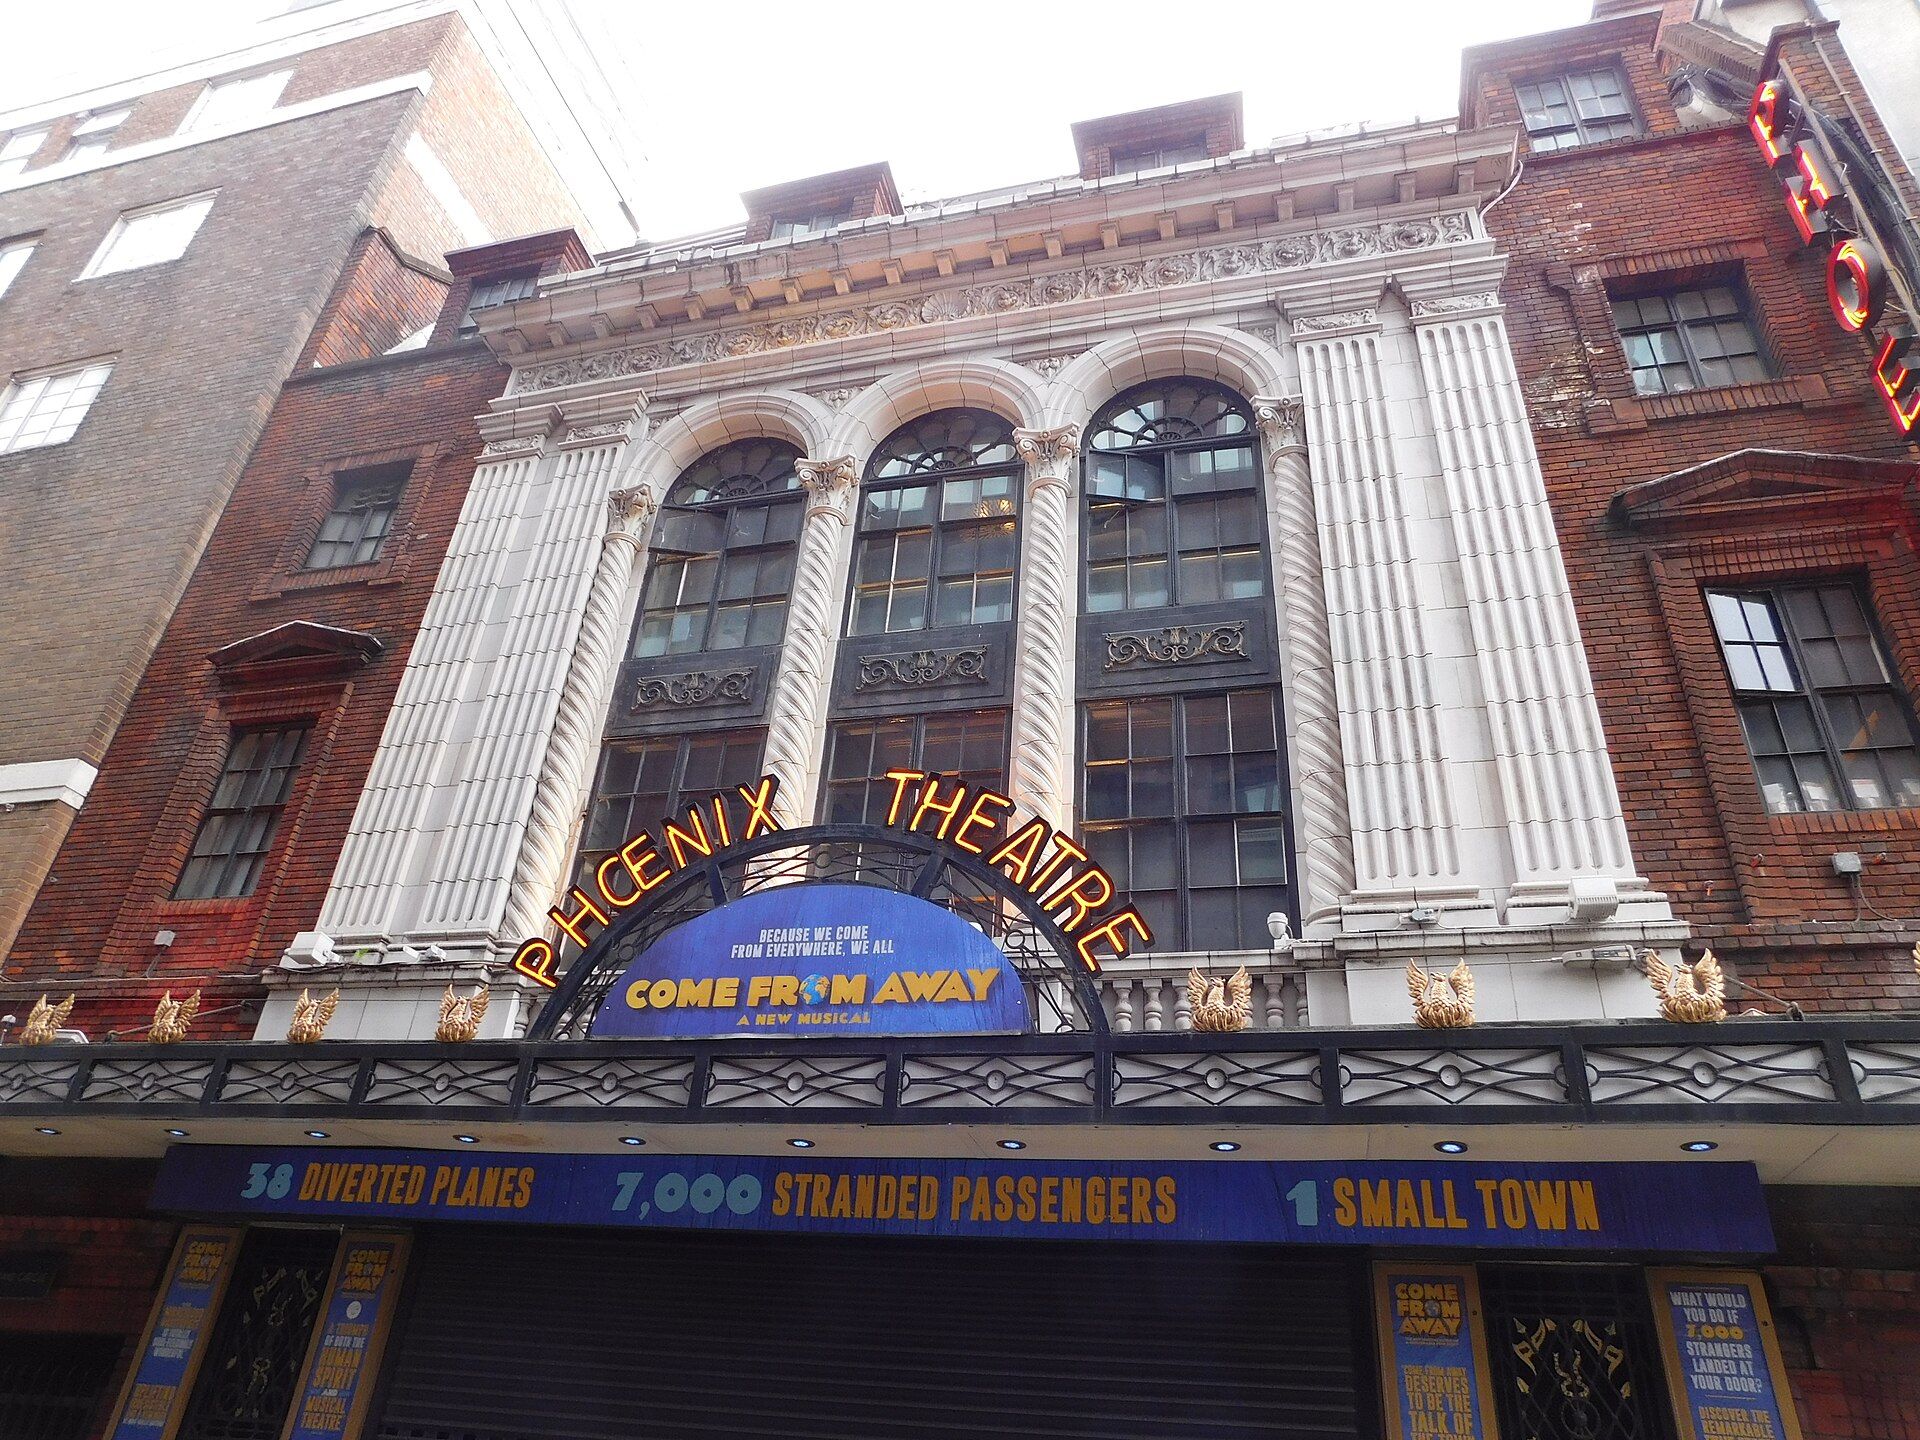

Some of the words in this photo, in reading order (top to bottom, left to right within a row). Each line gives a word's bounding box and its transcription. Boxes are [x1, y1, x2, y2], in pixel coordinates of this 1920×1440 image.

[885, 767, 1155, 979] THEATRE
[759, 927, 810, 943] BECAUSE
[813, 926, 833, 941] WE
[836, 925, 869, 940] COME
[731, 944, 763, 959] FROM
[766, 941, 846, 958] EVERYWHERE,
[851, 940, 870, 955] WE
[872, 939, 894, 954] ALL
[625, 977, 741, 1010] COME
[747, 972, 868, 1007] FROM
[871, 967, 1000, 1005] AWAY
[736, 1014, 750, 1026] A
[755, 1013, 793, 1026] NEW
[798, 1011, 871, 1025] MUSICAL
[240, 1162, 295, 1200] 38
[299, 1162, 424, 1205] DIVERTED
[429, 1165, 535, 1209] PLANES
[614, 1172, 763, 1221] 7,000
[772, 1171, 938, 1220] STRANDED
[950, 1175, 1177, 1225] PASSENGERS
[1285, 1180, 1319, 1226] 1
[1333, 1177, 1468, 1229] SMALL
[1474, 1179, 1600, 1231] TOWN
[349, 1250, 390, 1264] COME
[343, 1277, 383, 1292] AWAY
[1396, 1283, 1458, 1300] COME
[1671, 1292, 1703, 1307] WHAT
[1705, 1293, 1747, 1308] WOULD
[1684, 1308, 1706, 1322] YOU
[1709, 1309, 1725, 1323] DO
[1726, 1309, 1740, 1324] IF
[1400, 1317, 1462, 1336] AWAY
[324, 1334, 335, 1347] OF
[352, 1336, 366, 1349] THE
[1687, 1341, 1753, 1359] STRANGERS
[320, 1348, 362, 1369] HUMAN
[1693, 1359, 1738, 1374] LANDED
[1739, 1360, 1754, 1376] AT
[314, 1365, 358, 1390] SPIRIT
[1405, 1375, 1470, 1395] DESERVES
[1691, 1375, 1723, 1391] YOUR
[1725, 1377, 1763, 1393] DOOR?
[305, 1397, 347, 1415] MUSICAL
[1407, 1392, 1424, 1411] TO
[1427, 1393, 1443, 1412] BE
[1446, 1394, 1472, 1414] THE
[302, 1413, 343, 1431] THEATRE
[1409, 1411, 1450, 1433] TALK
[1454, 1413, 1473, 1436] OF
[1699, 1407, 1749, 1422] DISCOVER
[1751, 1410, 1771, 1424] THE
[1702, 1420, 1775, 1439] REMARKABLE
